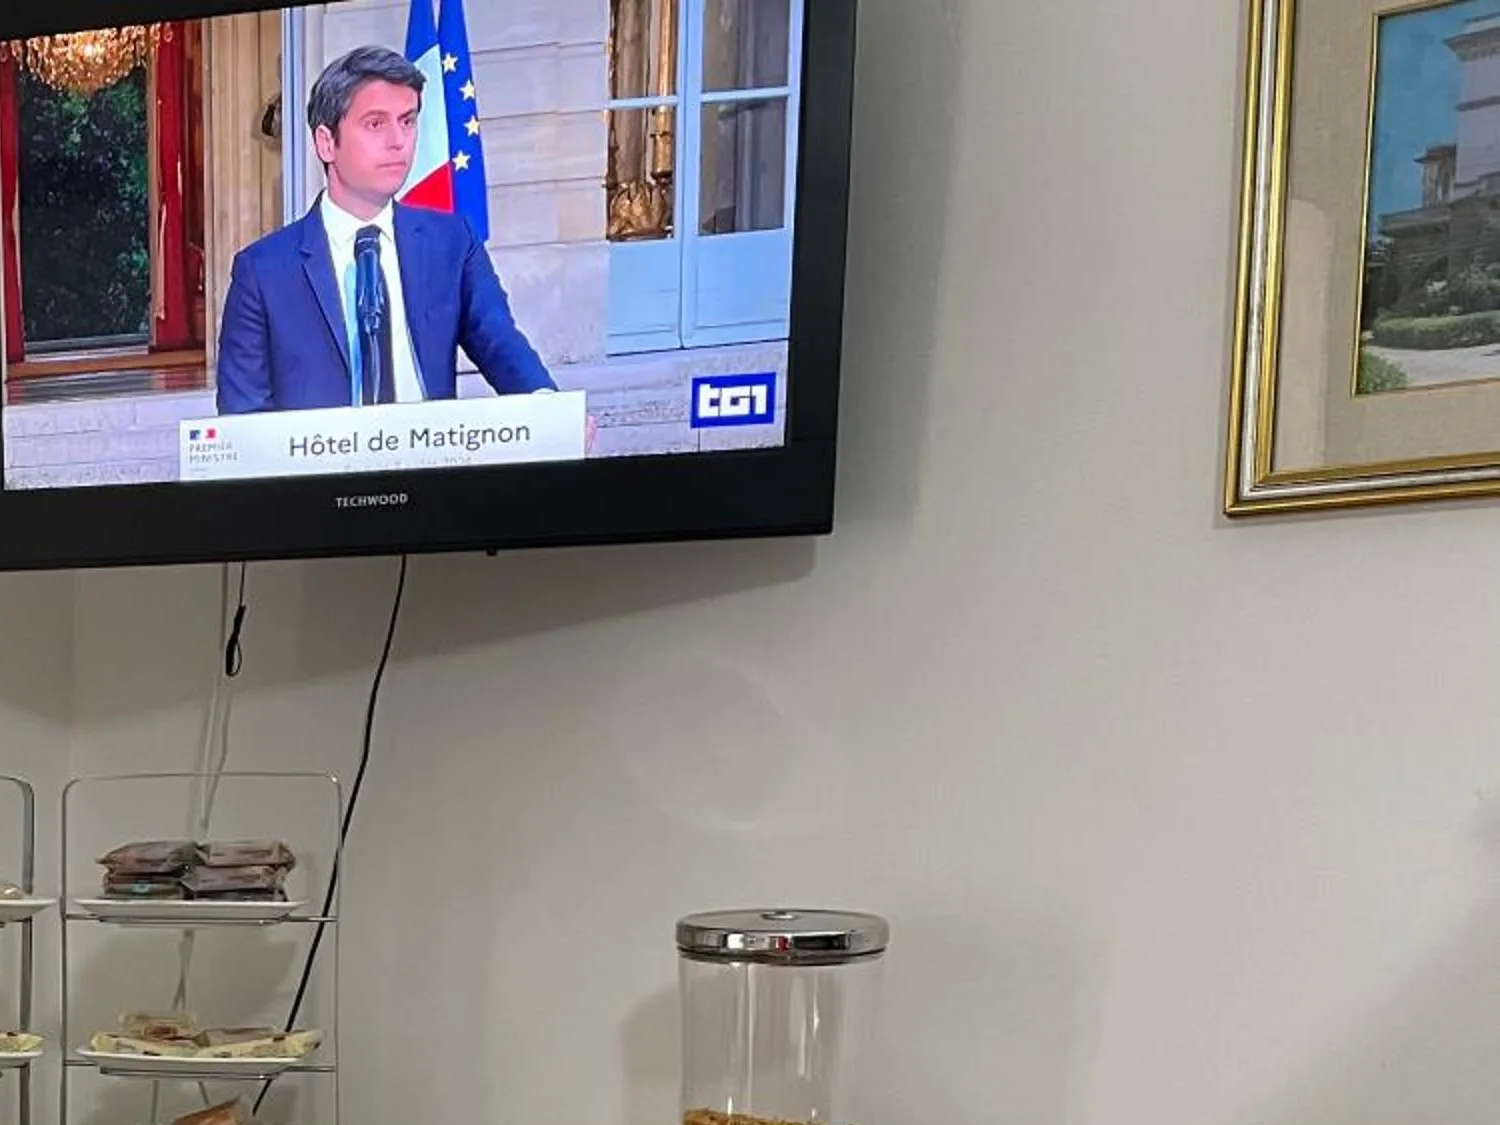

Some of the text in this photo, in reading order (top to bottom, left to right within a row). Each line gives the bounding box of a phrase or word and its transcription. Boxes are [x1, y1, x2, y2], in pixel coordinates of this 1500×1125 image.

[288, 423, 531, 457] Hôtel de Matignon
[335, 493, 409, 508] TECHWOOD
